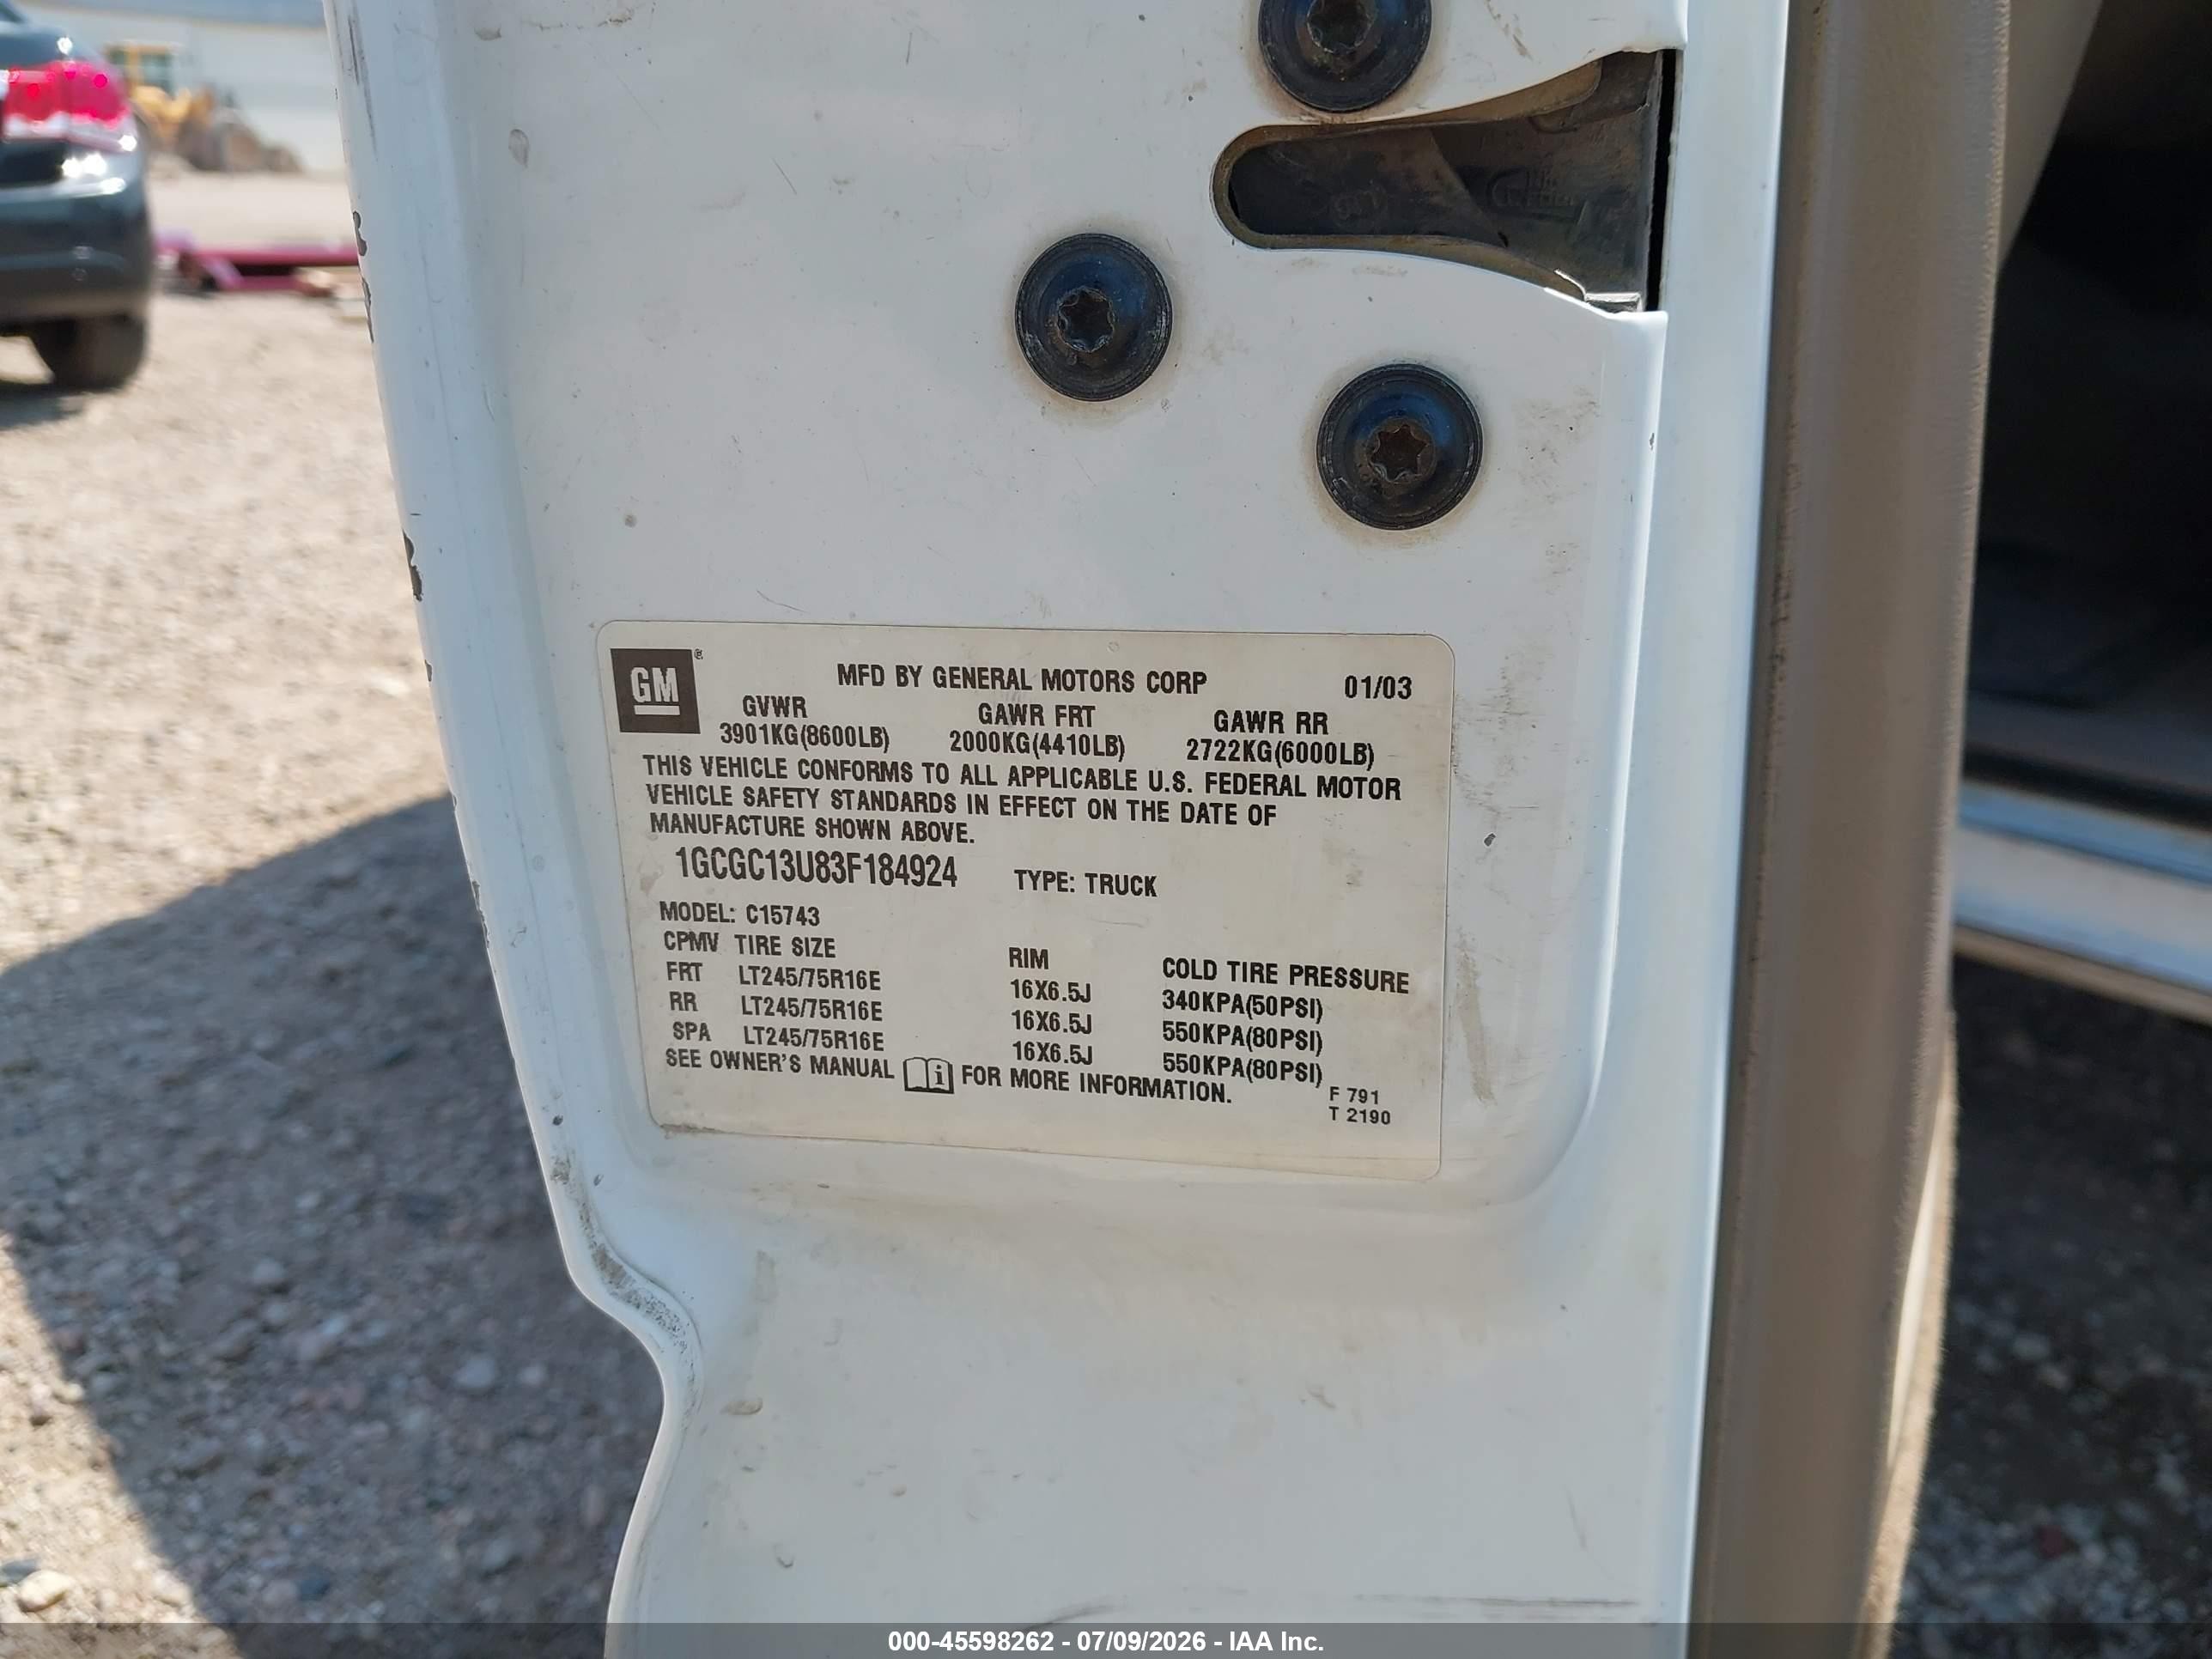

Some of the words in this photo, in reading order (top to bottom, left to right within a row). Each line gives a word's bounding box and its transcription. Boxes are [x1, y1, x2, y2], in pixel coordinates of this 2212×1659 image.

[630, 667, 678, 702] GM
[837, 664, 884, 686] MFD
[896, 665, 922, 687] BY
[933, 666, 1032, 690] GENERAL
[1042, 669, 1134, 692] MOTORS
[1147, 671, 1206, 694] CORP
[1345, 676, 1412, 699] 01/03
[743, 696, 807, 718] GVWR
[979, 703, 1044, 726] GAWR
[1055, 705, 1096, 727] FRT
[1214, 710, 1285, 733] GAWR
[1297, 712, 1328, 735] RR
[720, 723, 890, 753] 3901KG(8600LB)
[950, 731, 1125, 763] 2000KG(4410LB)
[1187, 738, 1374, 771] 2722KG(6000LB)
[642, 755, 692, 775] THIS
[700, 756, 787, 779] VEHICLE
[798, 759, 913, 782] CONFORMS
[921, 763, 949, 784] TO
[960, 764, 998, 786] ALL
[1008, 766, 1137, 791] APPLICABLE
[1149, 770, 1192, 793] U.S.
[1206, 772, 1306, 797] FEDERAL
[1317, 775, 1401, 800] MOTOR
[646, 784, 732, 805] VEHICLE
[743, 787, 819, 809] SAFETY
[831, 789, 956, 813] STANDARDS
[968, 793, 988, 815] IN
[1000, 795, 1076, 818] EFFECT
[1088, 799, 1116, 820] ON
[1127, 799, 1169, 822] THE
[1182, 802, 1237, 824] DATE
[1249, 805, 1276, 826] OF
[650, 812, 805, 837] MANUFACTURE
[816, 817, 890, 840] SHOWN
[902, 821, 974, 843] ABOVE.
[676, 847, 957, 887] 1GCGC13U83F184924
[1014, 870, 1074, 892] TYPE:
[1085, 873, 1157, 896] TRUCK
[659, 901, 735, 922] MODEL:
[746, 904, 819, 926] C15743
[665, 931, 719, 951] CPMV
[734, 934, 781, 956] TIRE
[792, 937, 836, 957] SIZE
[1009, 947, 1048, 969] RIM
[666, 962, 702, 981] FRT
[739, 965, 880, 990] LT245/75R16E
[1164, 957, 1217, 980] COLD
[1227, 961, 1278, 984] TIRE
[1290, 964, 1408, 994] PRESSURE
[670, 992, 698, 1012] RR
[1011, 979, 1091, 1003] 16X6.5J
[742, 995, 882, 1021] LT245/75R16E
[1162, 989, 1323, 1024] 340KPA(50PSI)
[673, 1022, 711, 1041] SPA
[1012, 1010, 1091, 1034] 16X6.5J
[744, 1026, 884, 1051] LT245/75R16E
[1162, 1021, 1323, 1056] 550KPA(80PSI)
[1012, 1041, 1092, 1065] 16X6.5J
[666, 1048, 702, 1067] SEE
[811, 1055, 894, 1079] MANUAL
[963, 1065, 1001, 1086] FOR
[1011, 1068, 1069, 1091] MORE
[1080, 1072, 1231, 1104] INFORMATION.
[1162, 1053, 1323, 1088] 550KPA(80PSI)
[1330, 1086, 1339, 1101] F
[1347, 1088, 1377, 1104] 791
[1329, 1106, 1339, 1121] T
[1347, 1108, 1390, 1125] 2190
